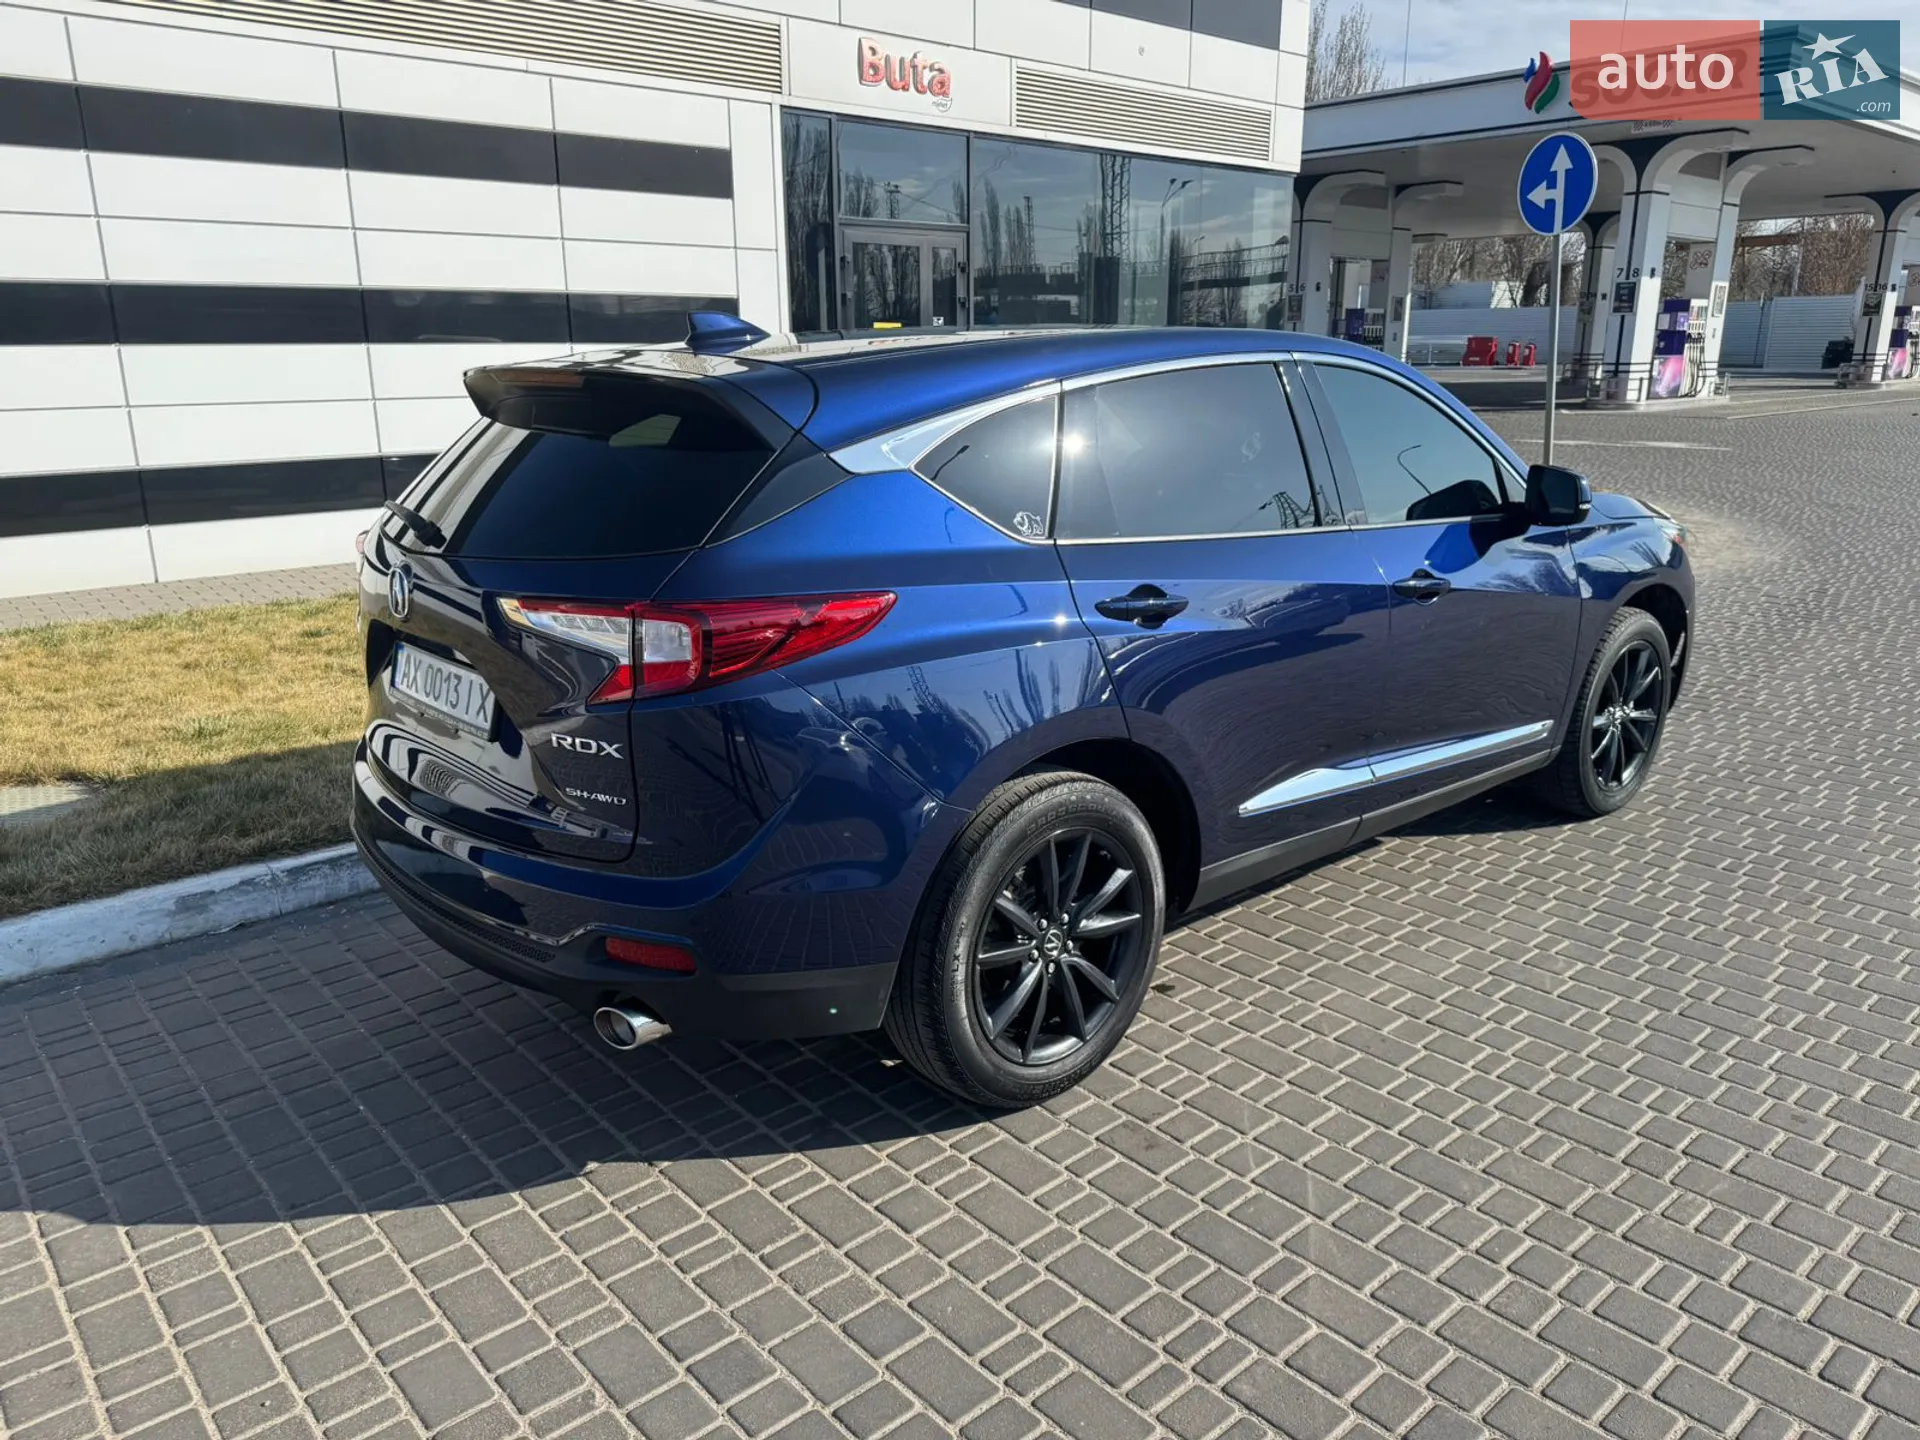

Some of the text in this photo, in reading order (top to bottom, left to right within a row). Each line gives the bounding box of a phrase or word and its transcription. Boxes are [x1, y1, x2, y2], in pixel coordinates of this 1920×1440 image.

[858, 38, 951, 98] Buta
[1616, 267, 1624, 278] 7
[1632, 267, 1640, 278] 8
[400, 652, 422, 694] AX
[423, 663, 462, 710] 0013
[465, 679, 490, 723] IX
[551, 733, 625, 760] RDX
[565, 787, 627, 806] SH-AWD
